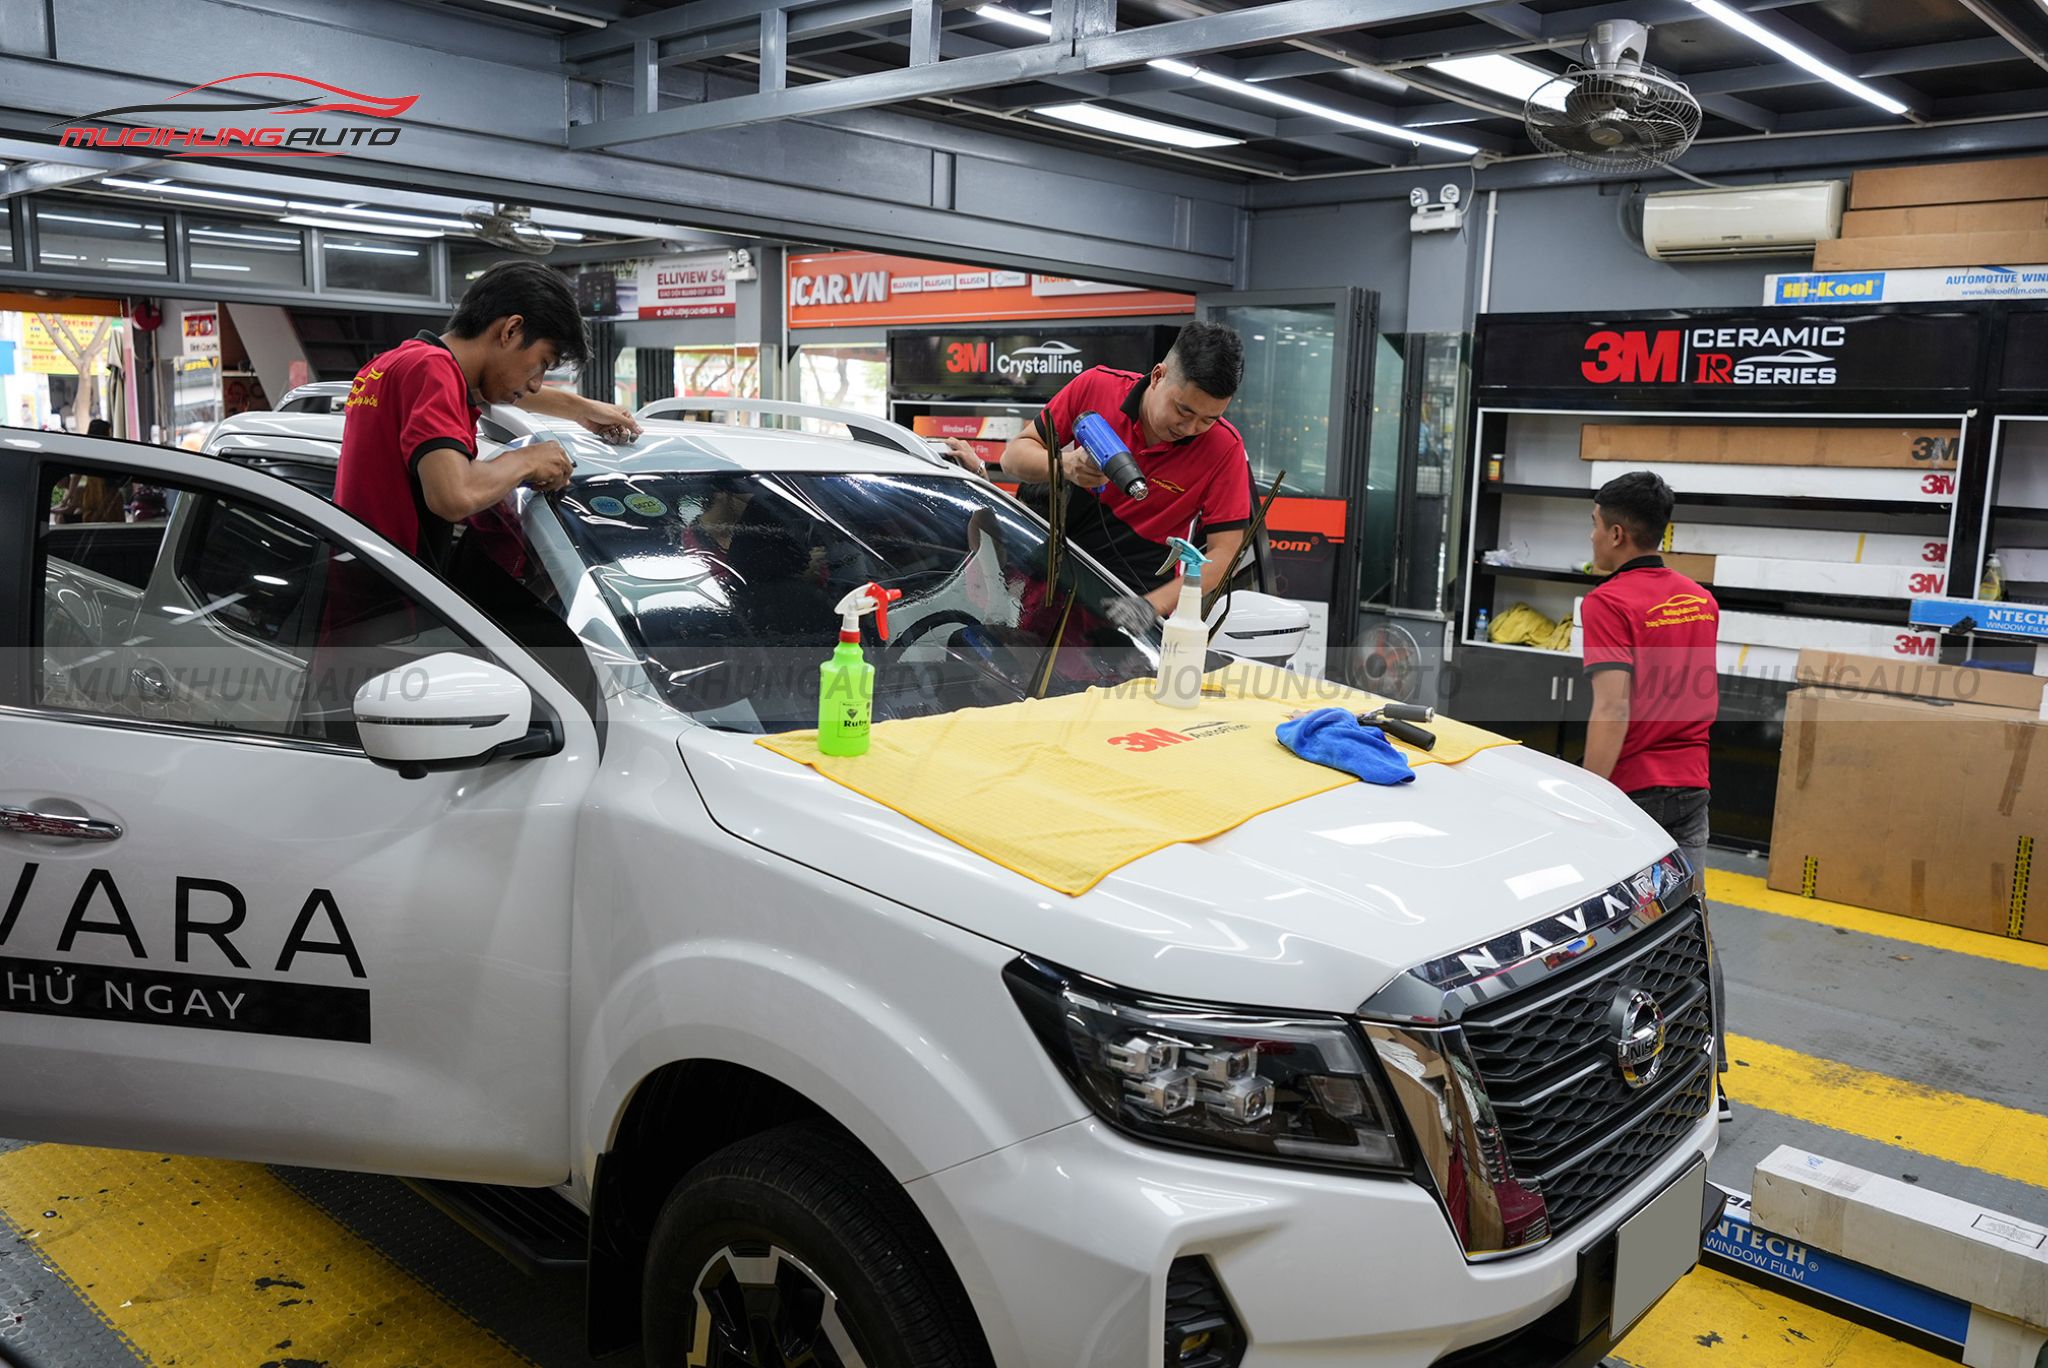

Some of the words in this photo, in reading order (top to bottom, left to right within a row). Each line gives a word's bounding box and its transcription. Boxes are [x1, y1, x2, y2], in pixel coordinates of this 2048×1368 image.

[657, 270, 709, 286] ELLIVIEW
[711, 268, 726, 283] S4
[1946, 274, 2018, 285] AUTOMOTIVE
[2022, 273, 2048, 283] WIN
[1783, 279, 1874, 298] Hi-Kool
[1692, 326, 1845, 348] CERAMIC
[946, 342, 987, 373] 3M
[997, 355, 1083, 377] Crystalline
[1581, 330, 1681, 384] 3M
[1733, 364, 1837, 385] SERIES
[1912, 436, 1960, 461] 3M
[1921, 474, 1956, 495] 3M
[1908, 573, 1945, 593] 3M
[1986, 621, 2026, 632] WINDOW
[1893, 634, 1936, 657] 3M
[843, 719, 867, 728] Ruby
[1107, 727, 1195, 753] 3M
[104, 980, 246, 1020] NGAY
[1710, 1220, 1808, 1266] NTECH
[1706, 1237, 1768, 1266] WINDOW
[1770, 1259, 1805, 1281] FILM
